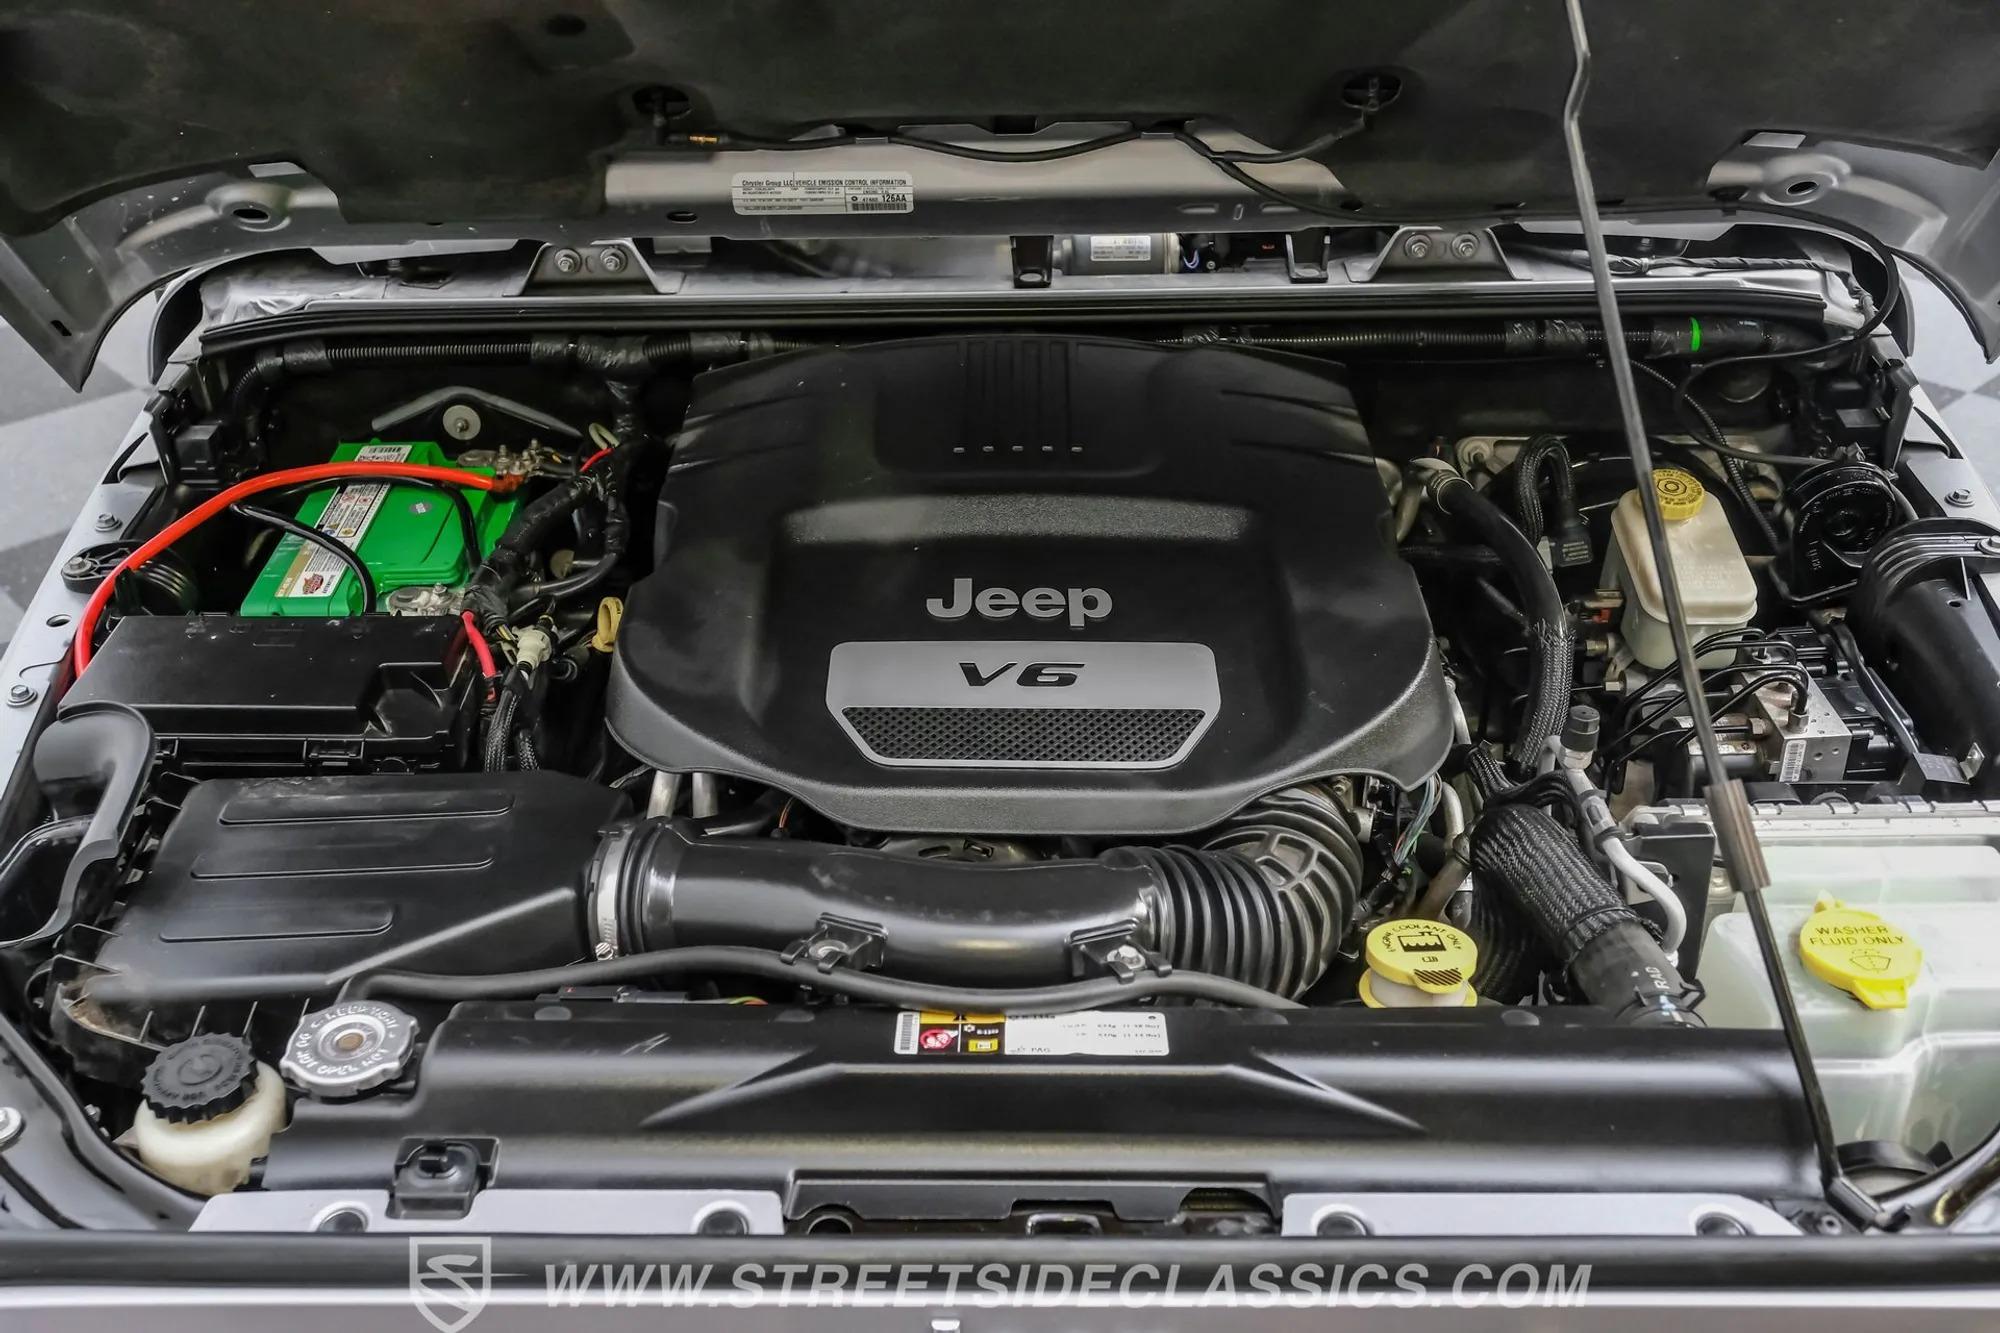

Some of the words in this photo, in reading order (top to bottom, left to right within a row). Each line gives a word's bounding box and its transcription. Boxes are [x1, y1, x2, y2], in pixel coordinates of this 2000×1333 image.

[742, 179, 764, 187] Chrysler
[765, 179, 782, 188] Group
[783, 179, 793, 187] LLC
[882, 193, 907, 203] 126AA
[925, 577, 1113, 628] Jeep
[958, 661, 1086, 687] V6
[1391, 923, 1446, 933] COOLANT
[1446, 933, 1462, 950] ONLY
[1815, 925, 1889, 935] WASHER
[1809, 936, 1858, 946] FLUID
[1862, 935, 1904, 945] ONLY
[1645, 966, 1671, 990] RAD
